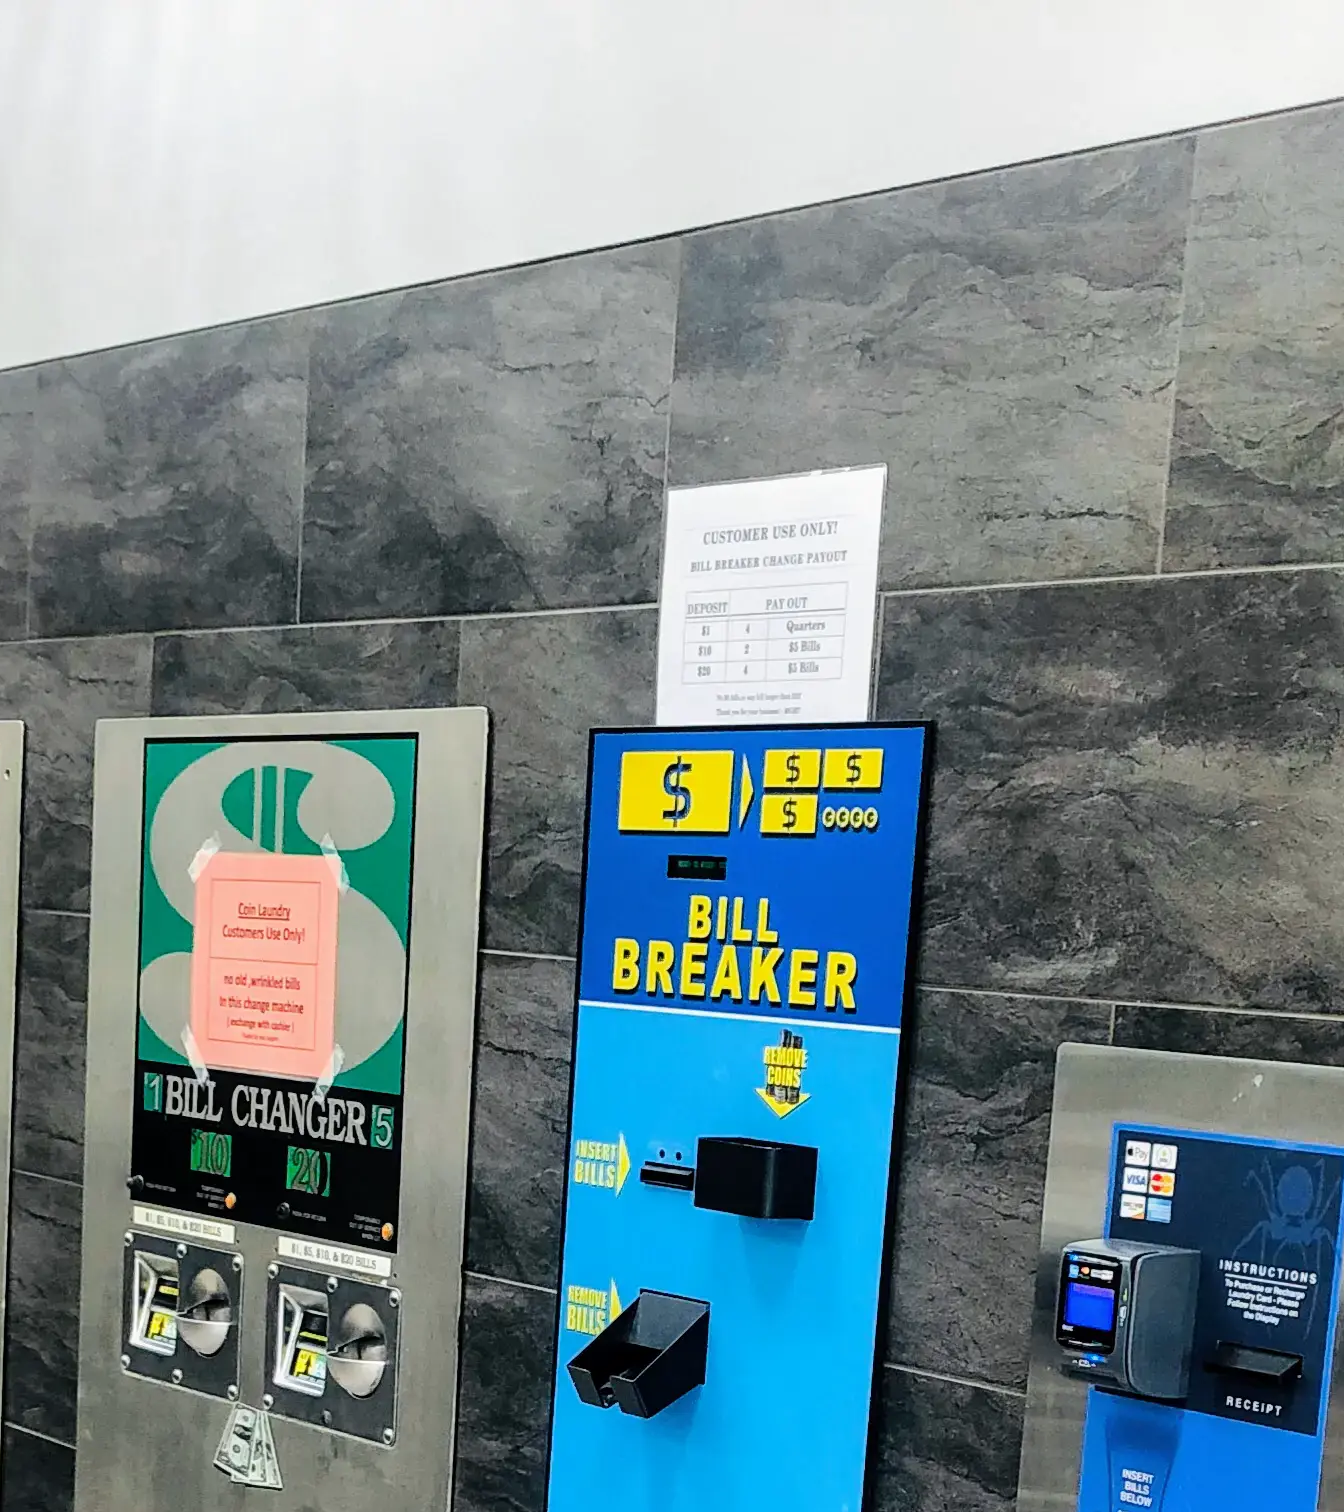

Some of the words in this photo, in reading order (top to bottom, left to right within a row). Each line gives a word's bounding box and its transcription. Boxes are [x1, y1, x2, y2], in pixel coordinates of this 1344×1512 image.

[703, 527, 769, 545] CUSTOMER
[772, 525, 797, 539] USE
[800, 521, 838, 537] ONLY!
[690, 560, 712, 573] BILL
[714, 557, 760, 571] BREAKER
[762, 553, 804, 568] CHANGE
[806, 550, 848, 564] PAYOUT
[687, 602, 728, 615] DEPOSIT
[765, 598, 785, 611] PAY
[787, 597, 808, 610] OUT
[786, 620, 826, 634] Quarters
[801, 640, 821, 652] Bills
[238, 902, 256, 915] Coin
[258, 904, 291, 920] Laundry
[688, 895, 779, 944] BILL
[223, 924, 264, 940] Customers
[266, 926, 281, 940] Use
[283, 927, 305, 945] Only!
[613, 938, 857, 1010] BREAKER
[243, 996, 270, 1013] change
[271, 1000, 304, 1015] machine
[764, 1046, 808, 1068] REMOVE
[767, 1065, 801, 1089] COINS
[165, 1075, 224, 1122] BILL
[230, 1084, 368, 1146] CHANGER
[575, 1139, 617, 1163] INSERT
[574, 1159, 616, 1189] BILLS
[1127, 1174, 1146, 1186] VISA
[1219, 1259, 1317, 1285] INSTRUCTIONS
[568, 1284, 608, 1308] REMOVE
[566, 1305, 605, 1336] BILLS
[1225, 1395, 1283, 1417] RECEIPT
[1122, 1468, 1154, 1484] INSERT
[1120, 1491, 1153, 1507] BELOW
[1124, 1481, 1149, 1495] BILLS
